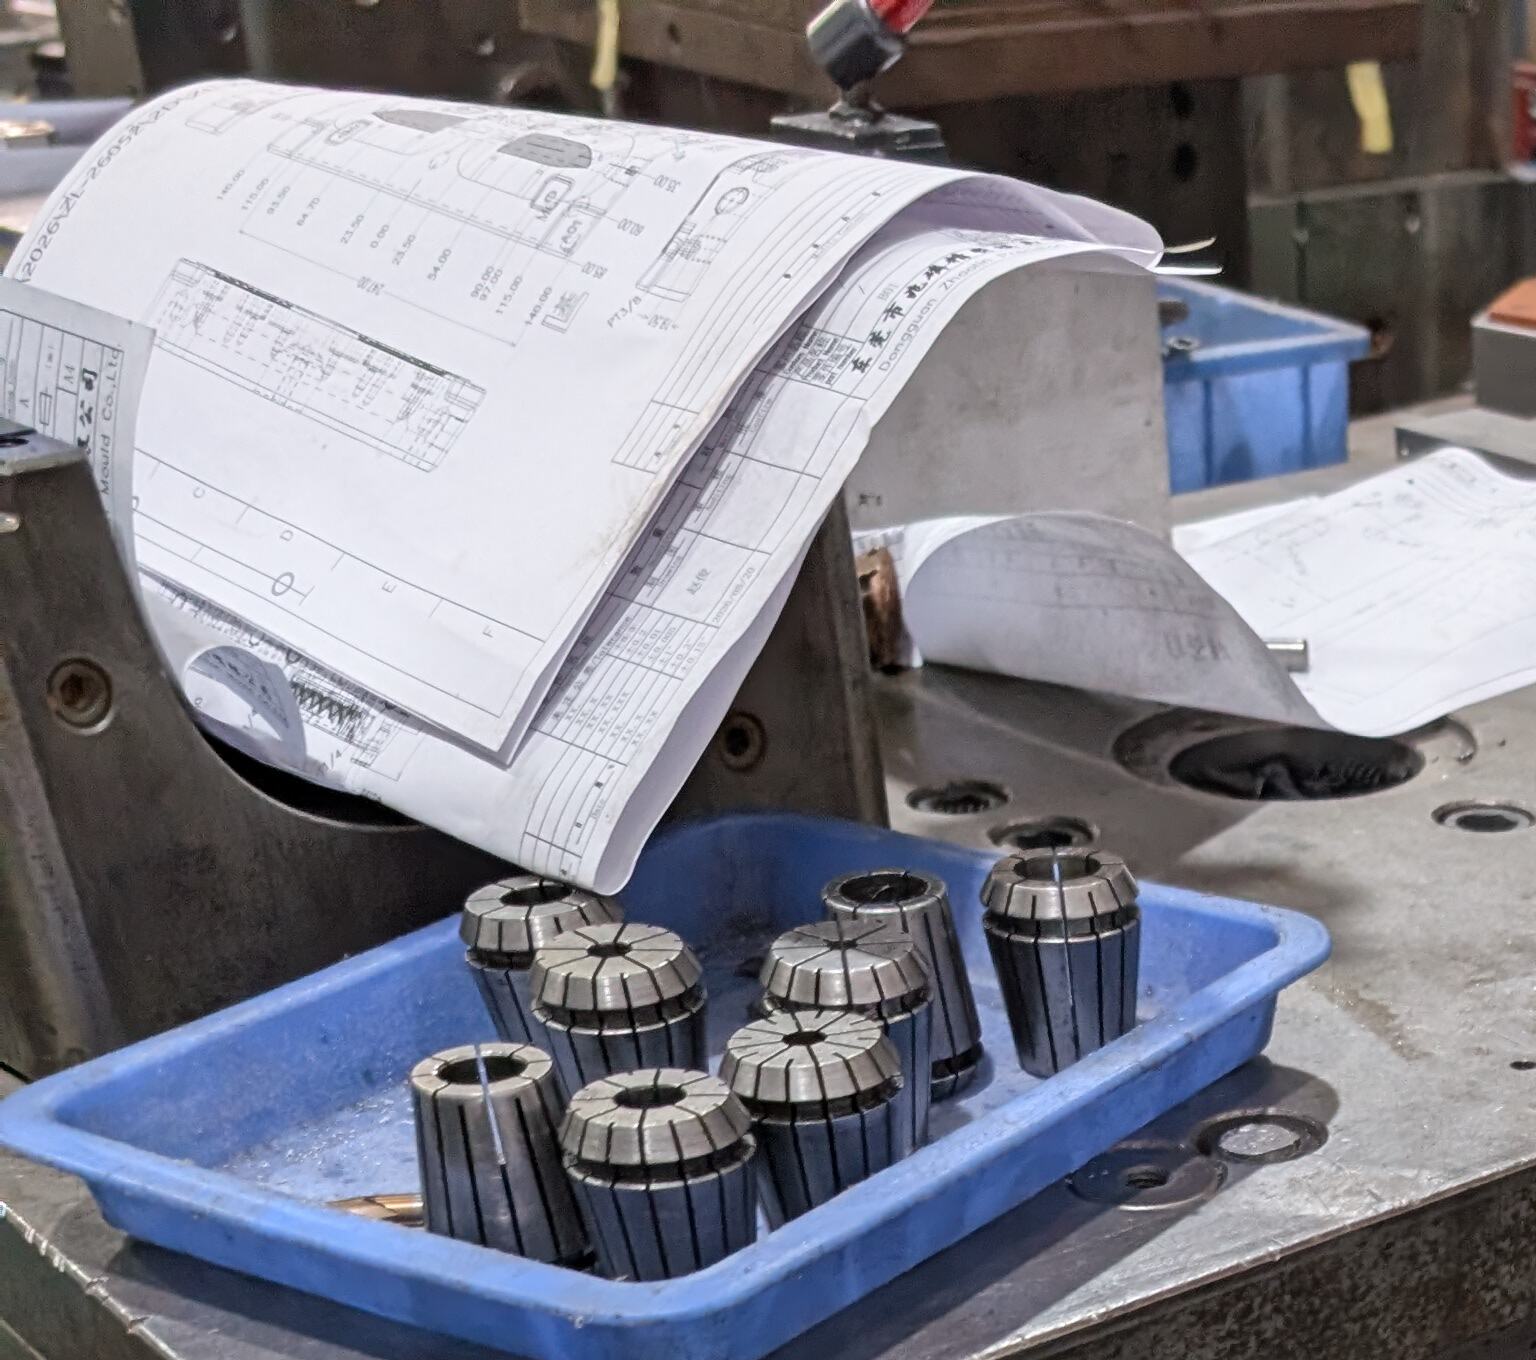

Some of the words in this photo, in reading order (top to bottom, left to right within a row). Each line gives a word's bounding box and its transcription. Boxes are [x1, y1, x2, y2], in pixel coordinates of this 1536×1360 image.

[369, 223, 390, 249] 0.00
[494, 274, 524, 315] 115.00
[524, 286, 553, 327] 140.00
[606, 295, 642, 329] PT3/8
[877, 297, 937, 372] Dongguan
[100, 433, 112, 496] Mould
[279, 529, 294, 543] D
[381, 580, 397, 594] E
[482, 625, 495, 639] F
